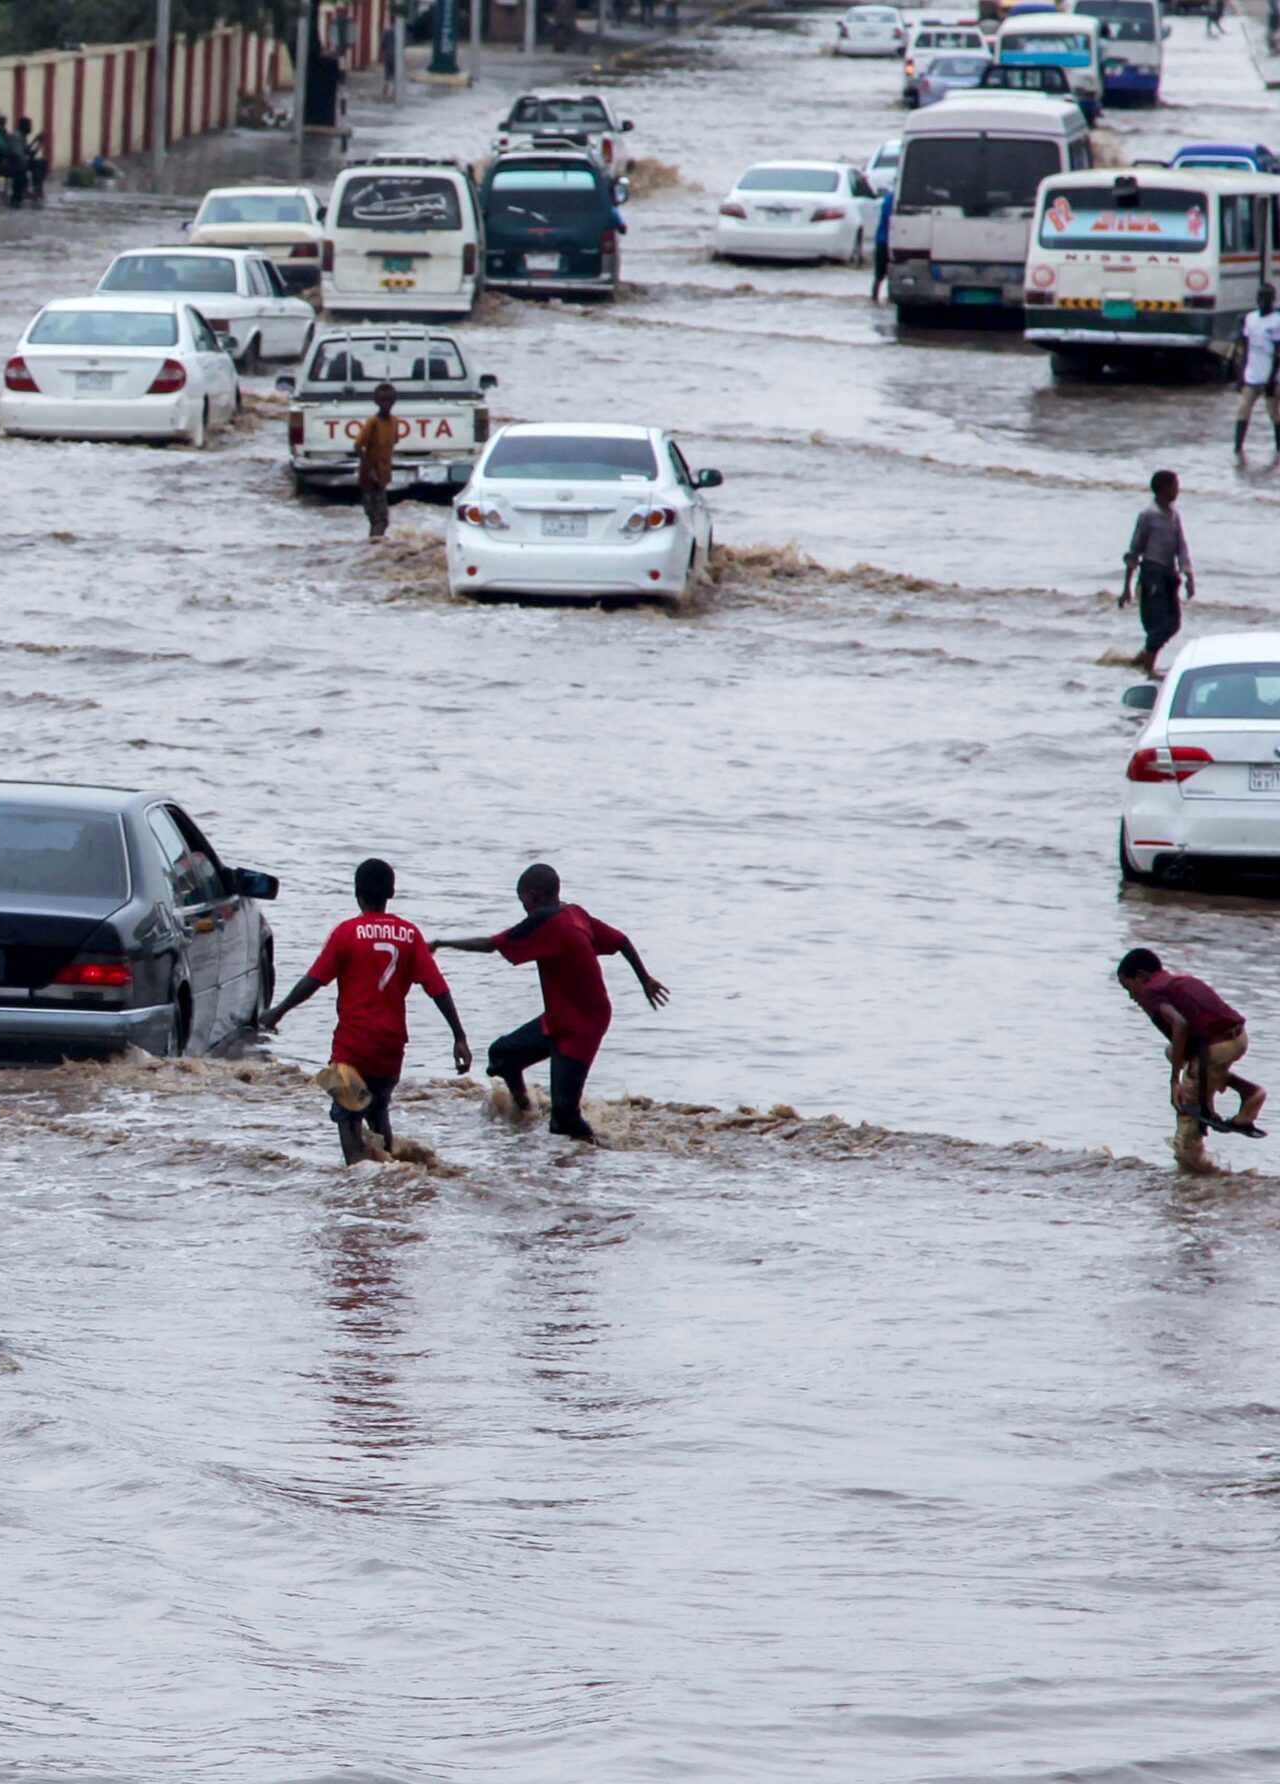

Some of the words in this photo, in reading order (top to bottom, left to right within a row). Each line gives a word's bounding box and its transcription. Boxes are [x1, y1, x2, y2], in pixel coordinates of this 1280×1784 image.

[1065, 253, 1181, 264] NISSAN
[324, 418, 453, 439] TOOTA
[356, 923, 415, 944] RONALDO
[372, 942, 399, 992] 7
